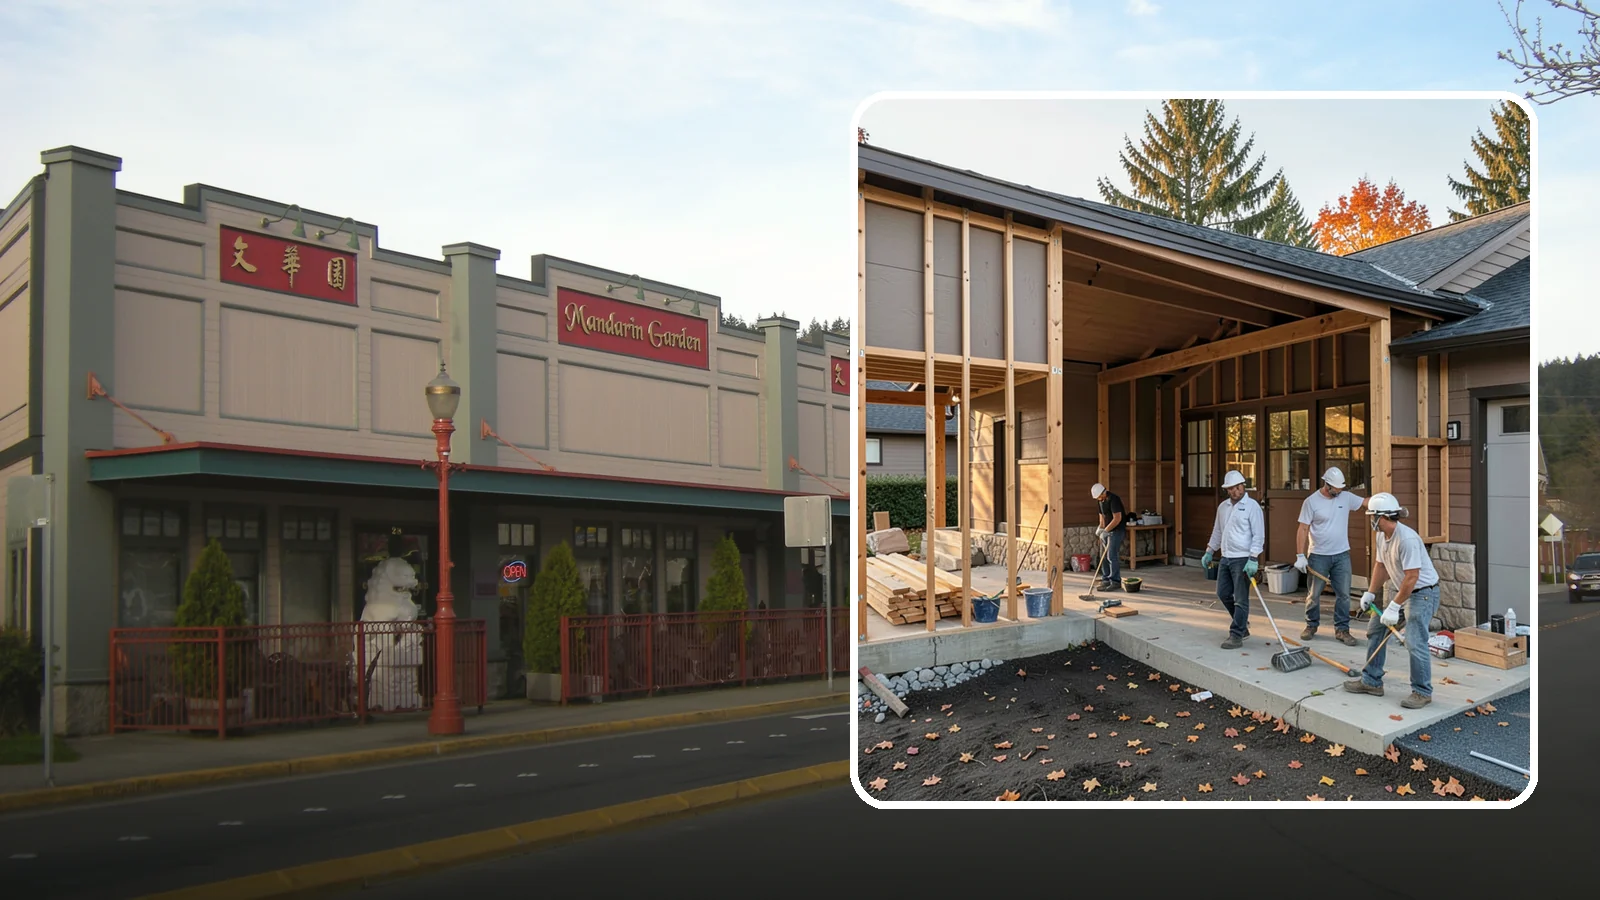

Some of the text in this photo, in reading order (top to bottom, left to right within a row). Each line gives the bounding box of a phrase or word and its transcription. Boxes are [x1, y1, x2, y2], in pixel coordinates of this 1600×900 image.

[231, 236, 346, 290] 文華園
[564, 302, 702, 352] Mandarin Garden
[503, 565, 527, 578] OPEN
